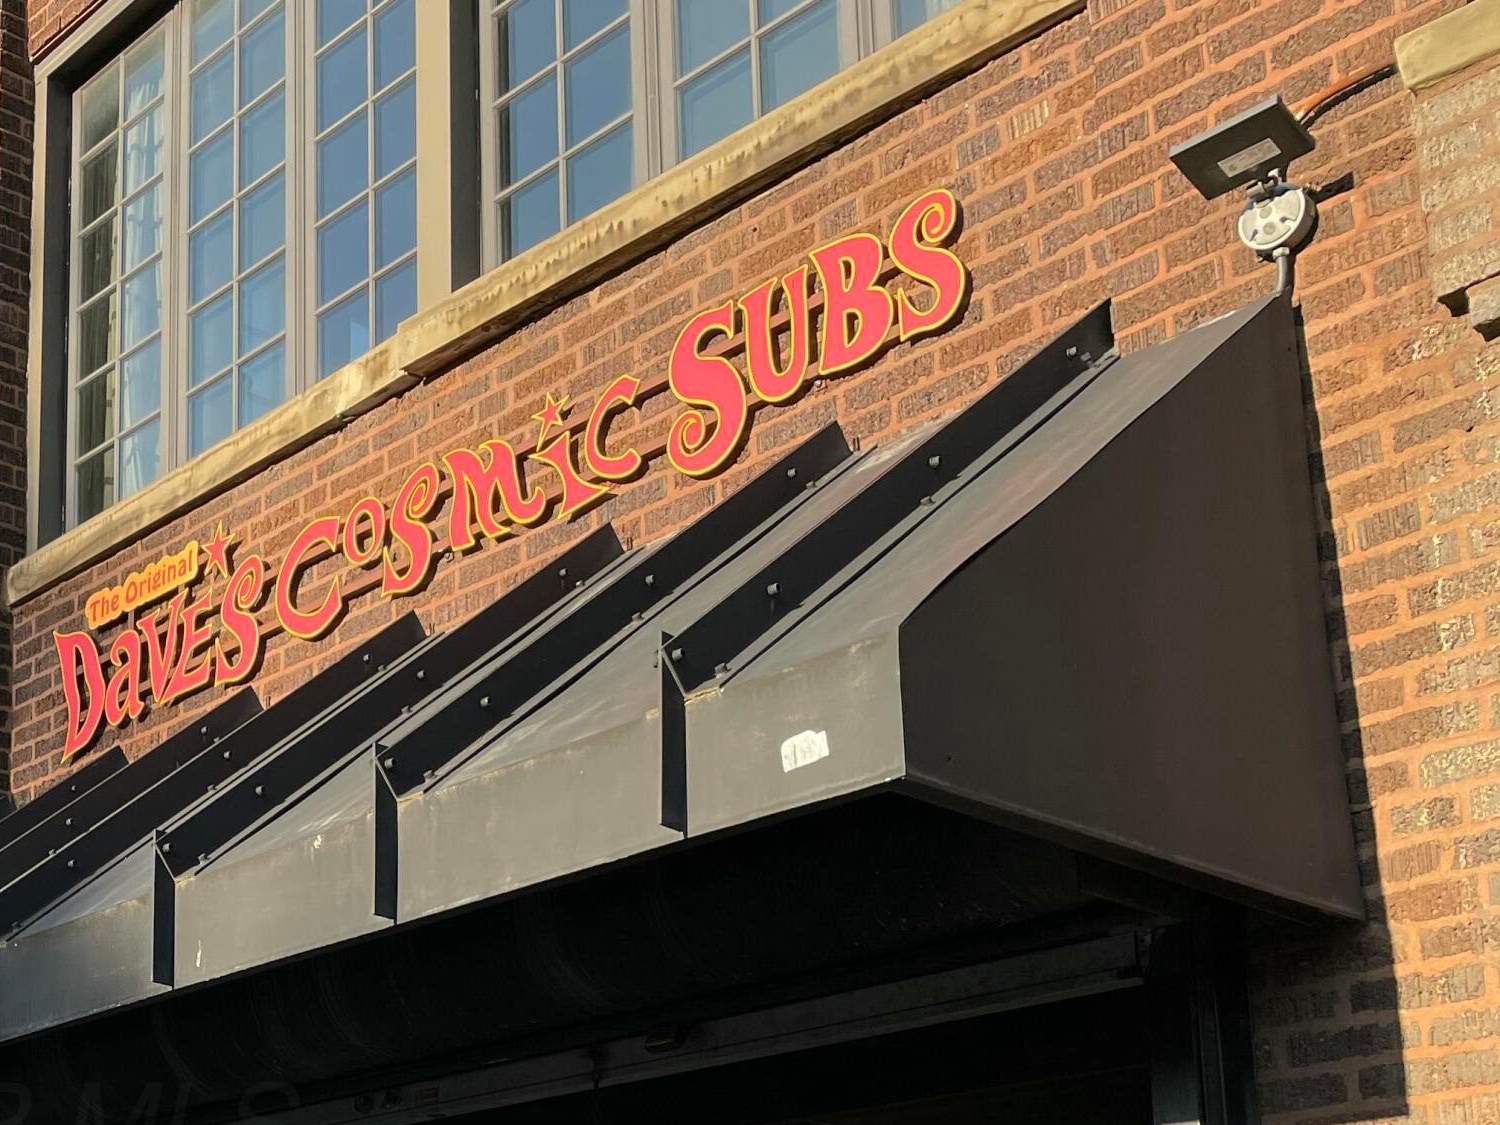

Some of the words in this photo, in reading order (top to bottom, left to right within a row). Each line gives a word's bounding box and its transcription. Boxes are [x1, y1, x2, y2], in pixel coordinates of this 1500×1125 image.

[666, 188, 967, 477] SUBS
[88, 594, 120, 625] The
[124, 557, 195, 601] Original
